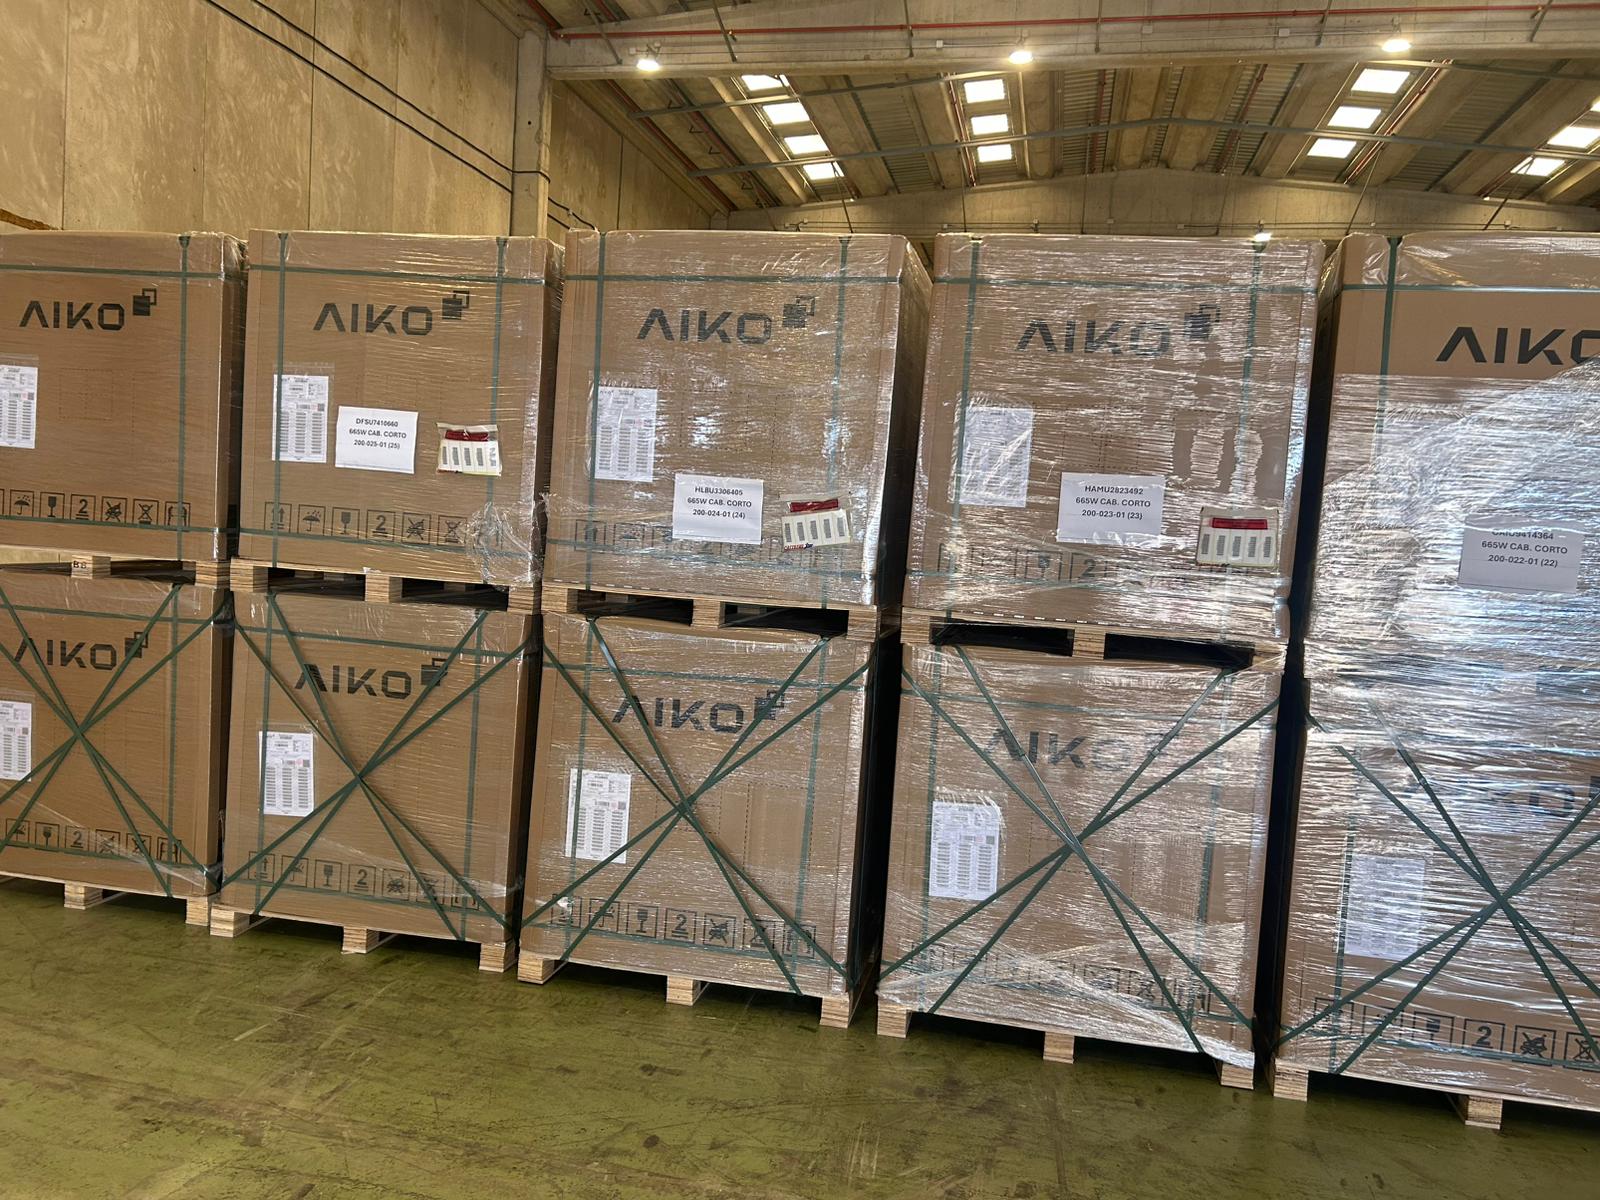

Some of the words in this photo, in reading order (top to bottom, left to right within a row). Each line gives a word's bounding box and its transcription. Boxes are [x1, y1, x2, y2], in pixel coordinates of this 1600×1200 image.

[19, 300, 125, 331] AIKO
[313, 302, 433, 336] AIKO
[636, 307, 772, 345] AIKO
[1015, 319, 1171, 357] AIKO
[383, 431, 407, 439] CORTO
[694, 486, 743, 496] HLBU3306405
[1084, 485, 1144, 495] HAMU2823492
[78, 498, 88, 514] 2
[687, 497, 707, 505] 665W
[708, 498, 725, 506] CAB.
[726, 500, 752, 508] CORTO
[1075, 496, 1098, 505] 665W
[1100, 498, 1120, 506] CAB.
[1121, 499, 1151, 508] CORTO
[692, 508, 730, 517] 200-024-01
[732, 511, 746, 520] (24)
[1081, 509, 1125, 518] 200-023-01
[1127, 511, 1143, 520] (23)
[375, 514, 386, 531] 2
[1481, 540, 1508, 550] 665W
[1509, 542, 1532, 552] CAB.
[1534, 544, 1568, 555] CORTO
[1487, 554, 1538, 566] 200-022-01
[1540, 558, 1558, 568] (22)
[294, 663, 412, 700] AIKO
[611, 695, 744, 734] AIKO
[356, 868, 368, 886] 2
[675, 913, 688, 931] 2
[1475, 1025, 1493, 1046] 2
